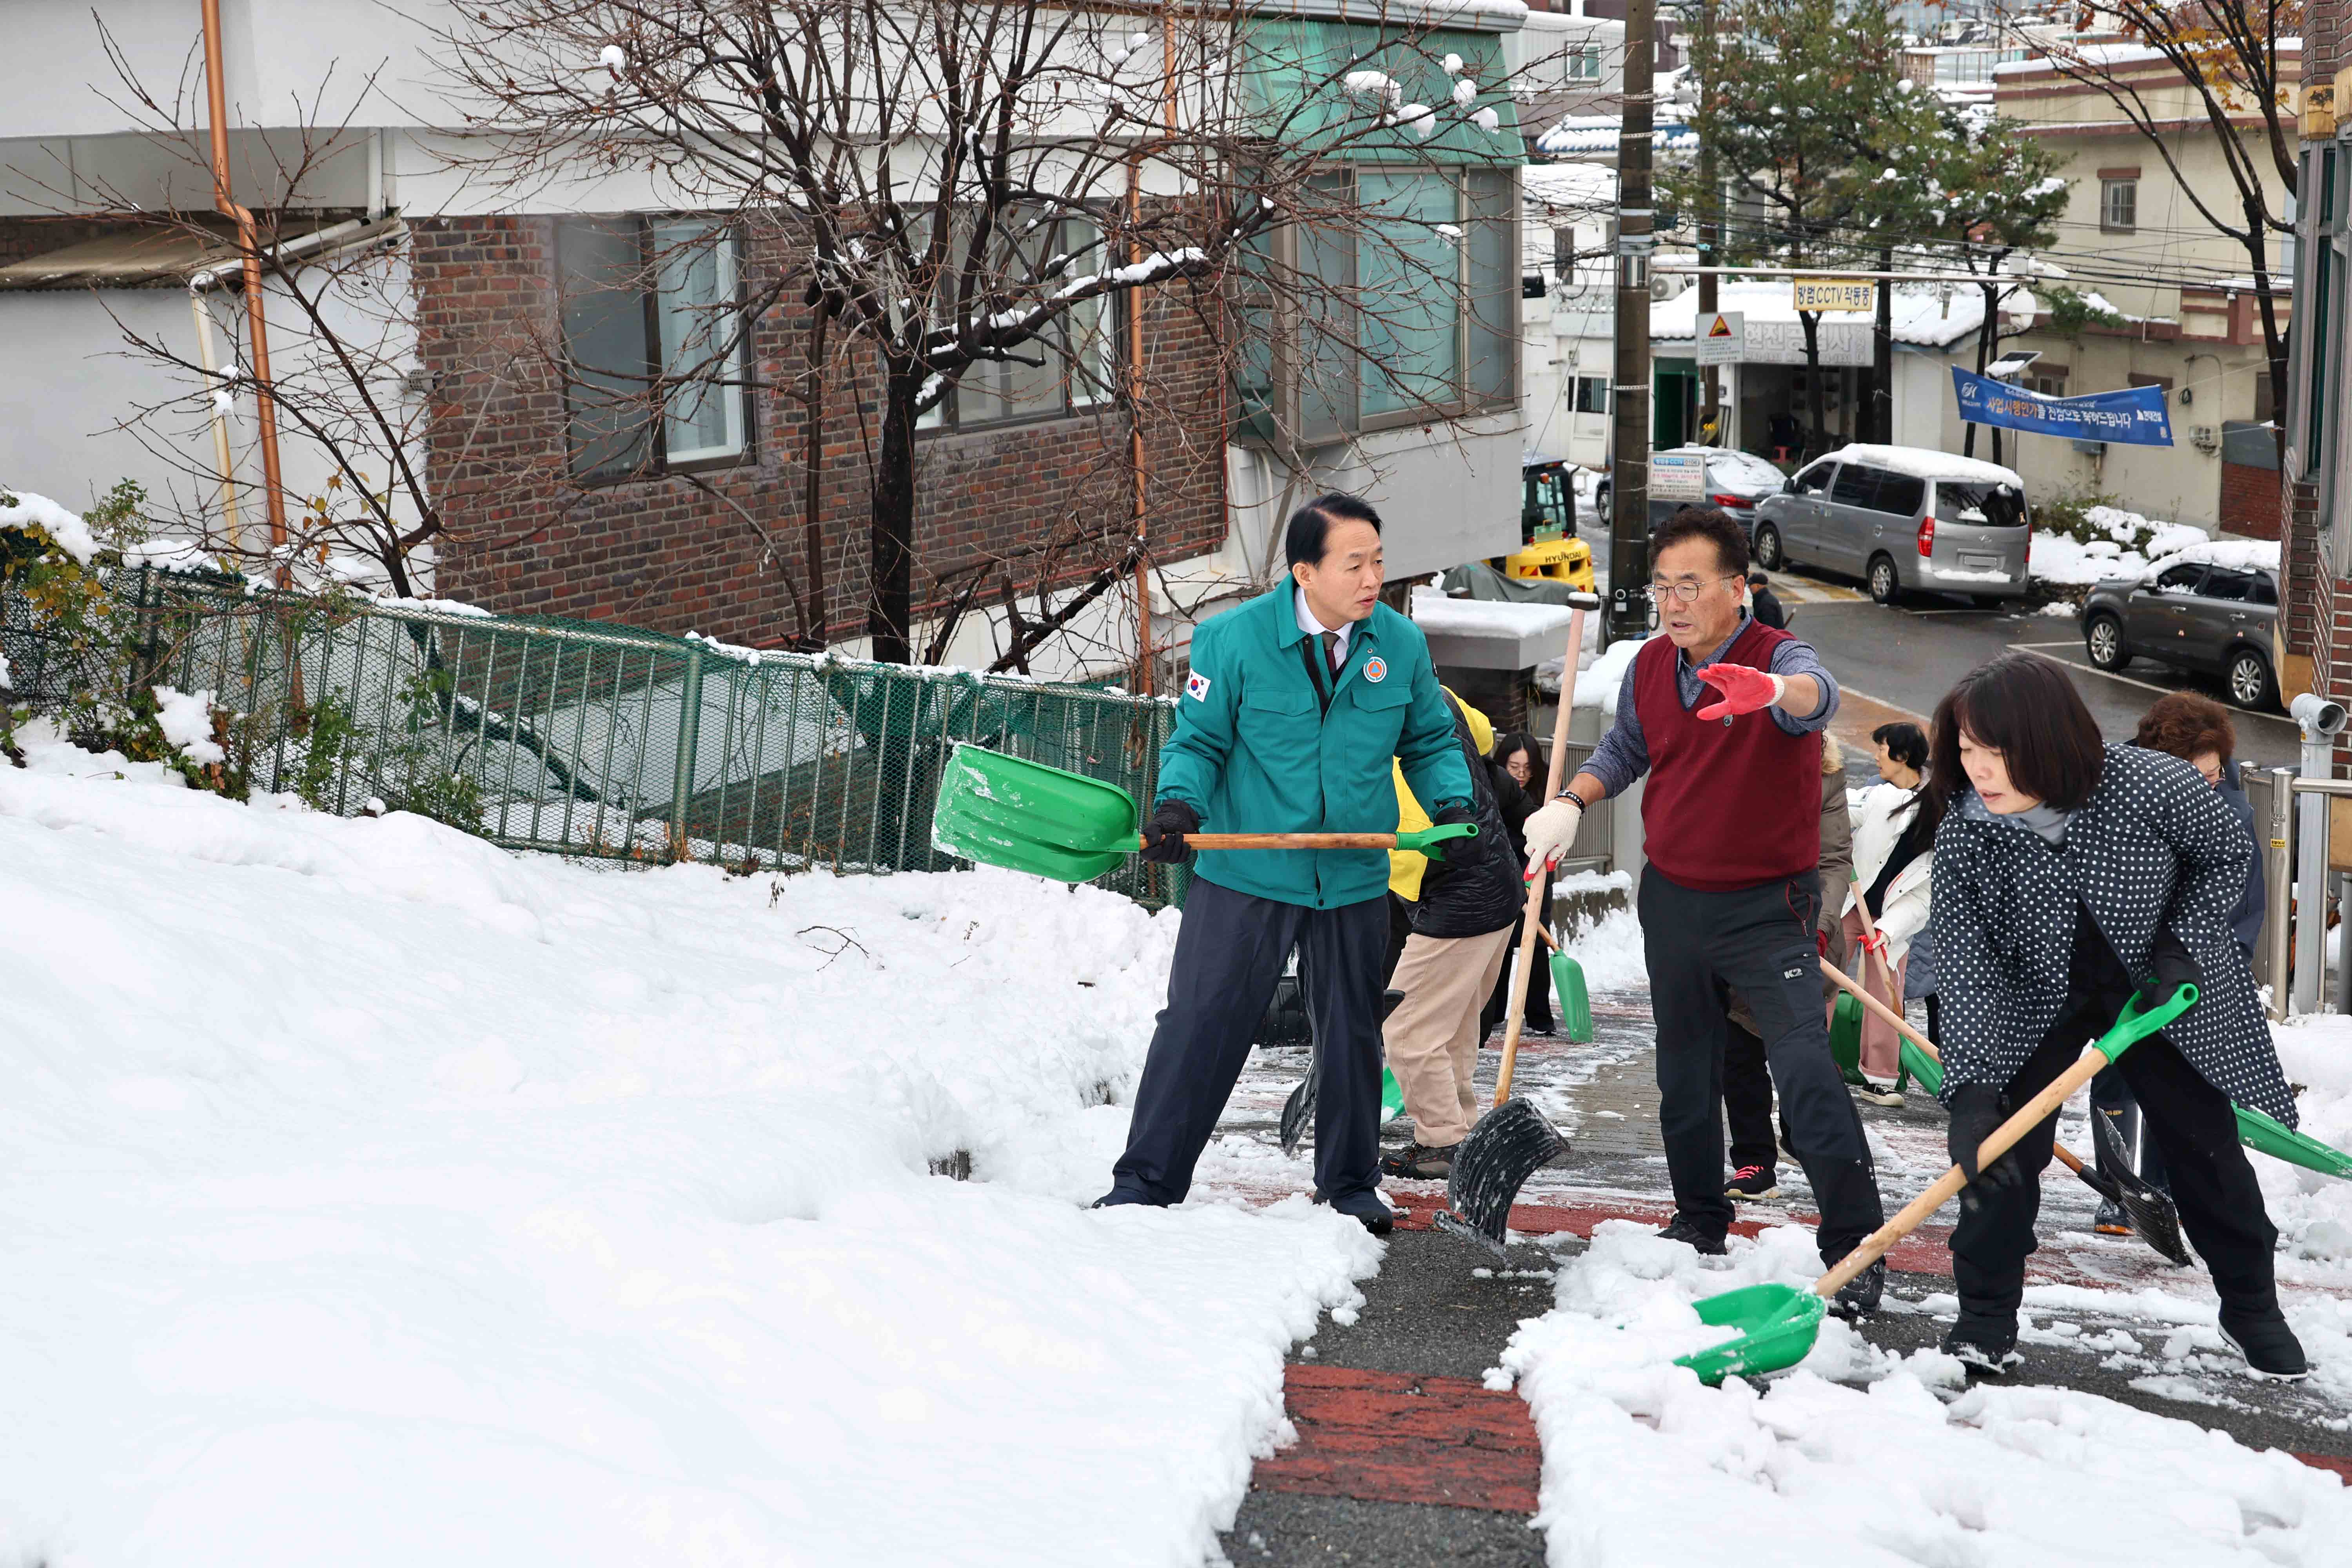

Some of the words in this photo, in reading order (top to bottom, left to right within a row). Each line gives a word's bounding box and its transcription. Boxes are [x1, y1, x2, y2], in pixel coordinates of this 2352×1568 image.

[1987, 396, 2046, 421] 사업시행인가를
[2082, 410, 2132, 429] 축하드립니다
[1545, 551, 1581, 563] HYUNDAI
[1784, 968, 1803, 979] K2
